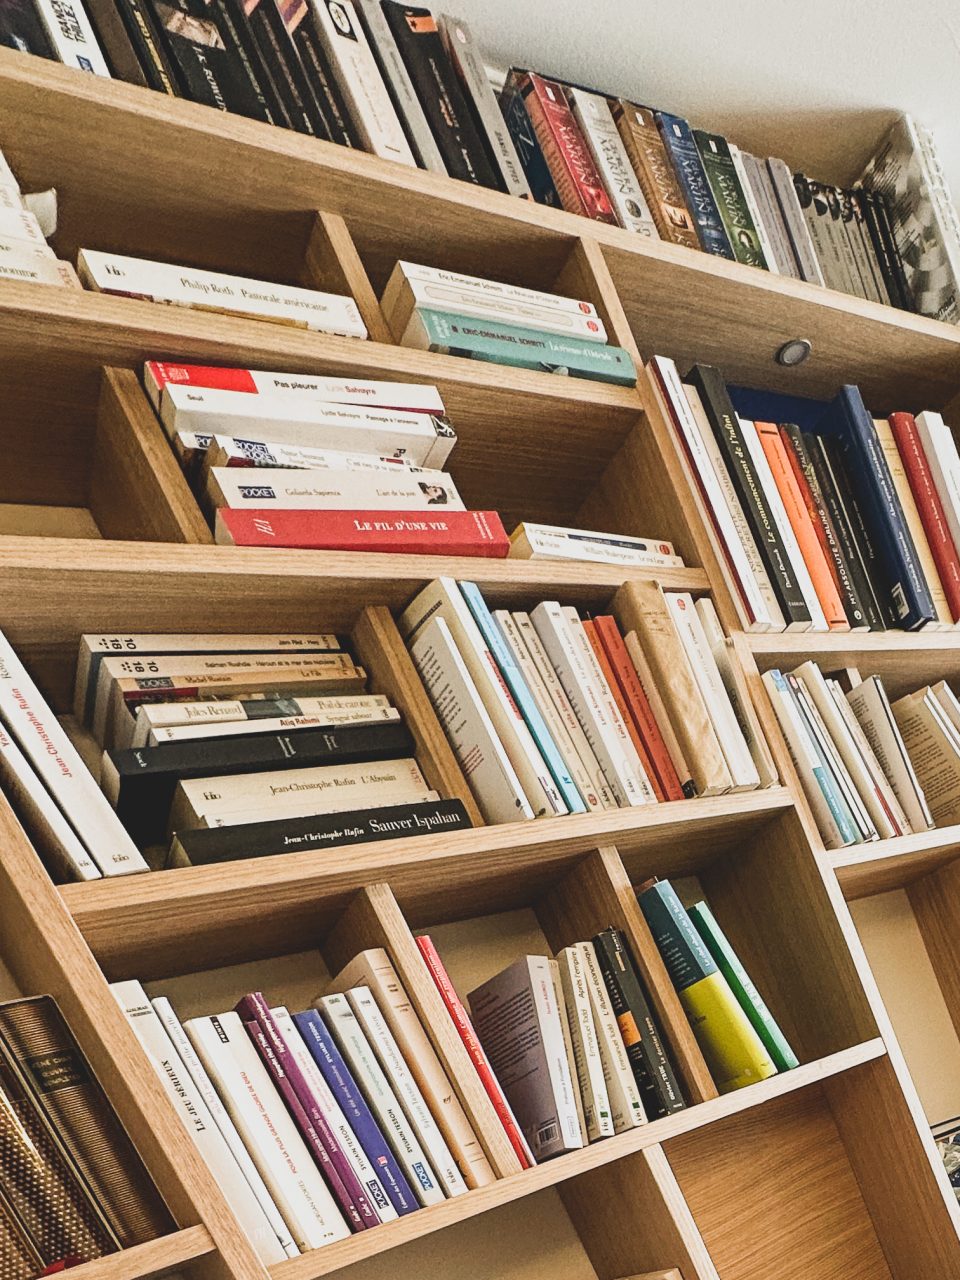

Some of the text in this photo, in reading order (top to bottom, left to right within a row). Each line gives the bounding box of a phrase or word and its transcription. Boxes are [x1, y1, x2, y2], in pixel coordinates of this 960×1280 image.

[553, 119, 593, 186] MARTIN
[593, 135, 633, 196] MARTIN
[637, 144, 677, 205] MARTIN
[674, 156, 714, 214] MARTIN
[708, 169, 747, 228] MARTIN
[178, 277, 210, 293] Philip
[209, 283, 236, 296] Roth
[239, 288, 282, 304] Pastorale
[272, 378, 376, 397] Pas pleurer Salvayre
[721, 412, 739, 445] l'infini
[733, 444, 745, 459] de
[239, 487, 275, 499] POCKET
[740, 460, 771, 530] commencement
[887, 502, 898, 518] Also
[353, 519, 447, 531] LE FIL D'UNE VIE
[765, 530, 776, 543] Le
[817, 507, 837, 546] DARLING
[831, 546, 853, 592] ABSOLUTE
[907, 562, 923, 593] Friedrich
[848, 592, 858, 605] MY
[9, 686, 73, 782] Jean-Christophe Rufin
[279, 718, 294, 727] Atiq
[295, 715, 320, 724] Rahimi
[269, 778, 331, 795] Jean-Christophe
[283, 807, 460, 848] Jean-Christophe Rufin Sauver Ispahan
[568, 951, 595, 1057] Emmanuel Todd Après l'empire
[580, 944, 626, 1072] Emmanuel Todd L'illusion économique
[307, 1019, 322, 1041] TESSON
[648, 1031, 662, 1054] dernier
[318, 1040, 334, 1064] SYLVAIN
[472, 1048, 484, 1065] Jean
[656, 1055, 664, 1064] Le
[239, 1069, 250, 1084] DIEU
[157, 1058, 205, 1133] LE JEU SÉRIEUX
[273, 1135, 284, 1150] PLUS
[387, 1107, 433, 1191] POCKET SYLVAIN TESSON
[285, 1157, 297, 1174] POUR
[338, 1123, 388, 1209] POCKET SYLVAIN TESSON
